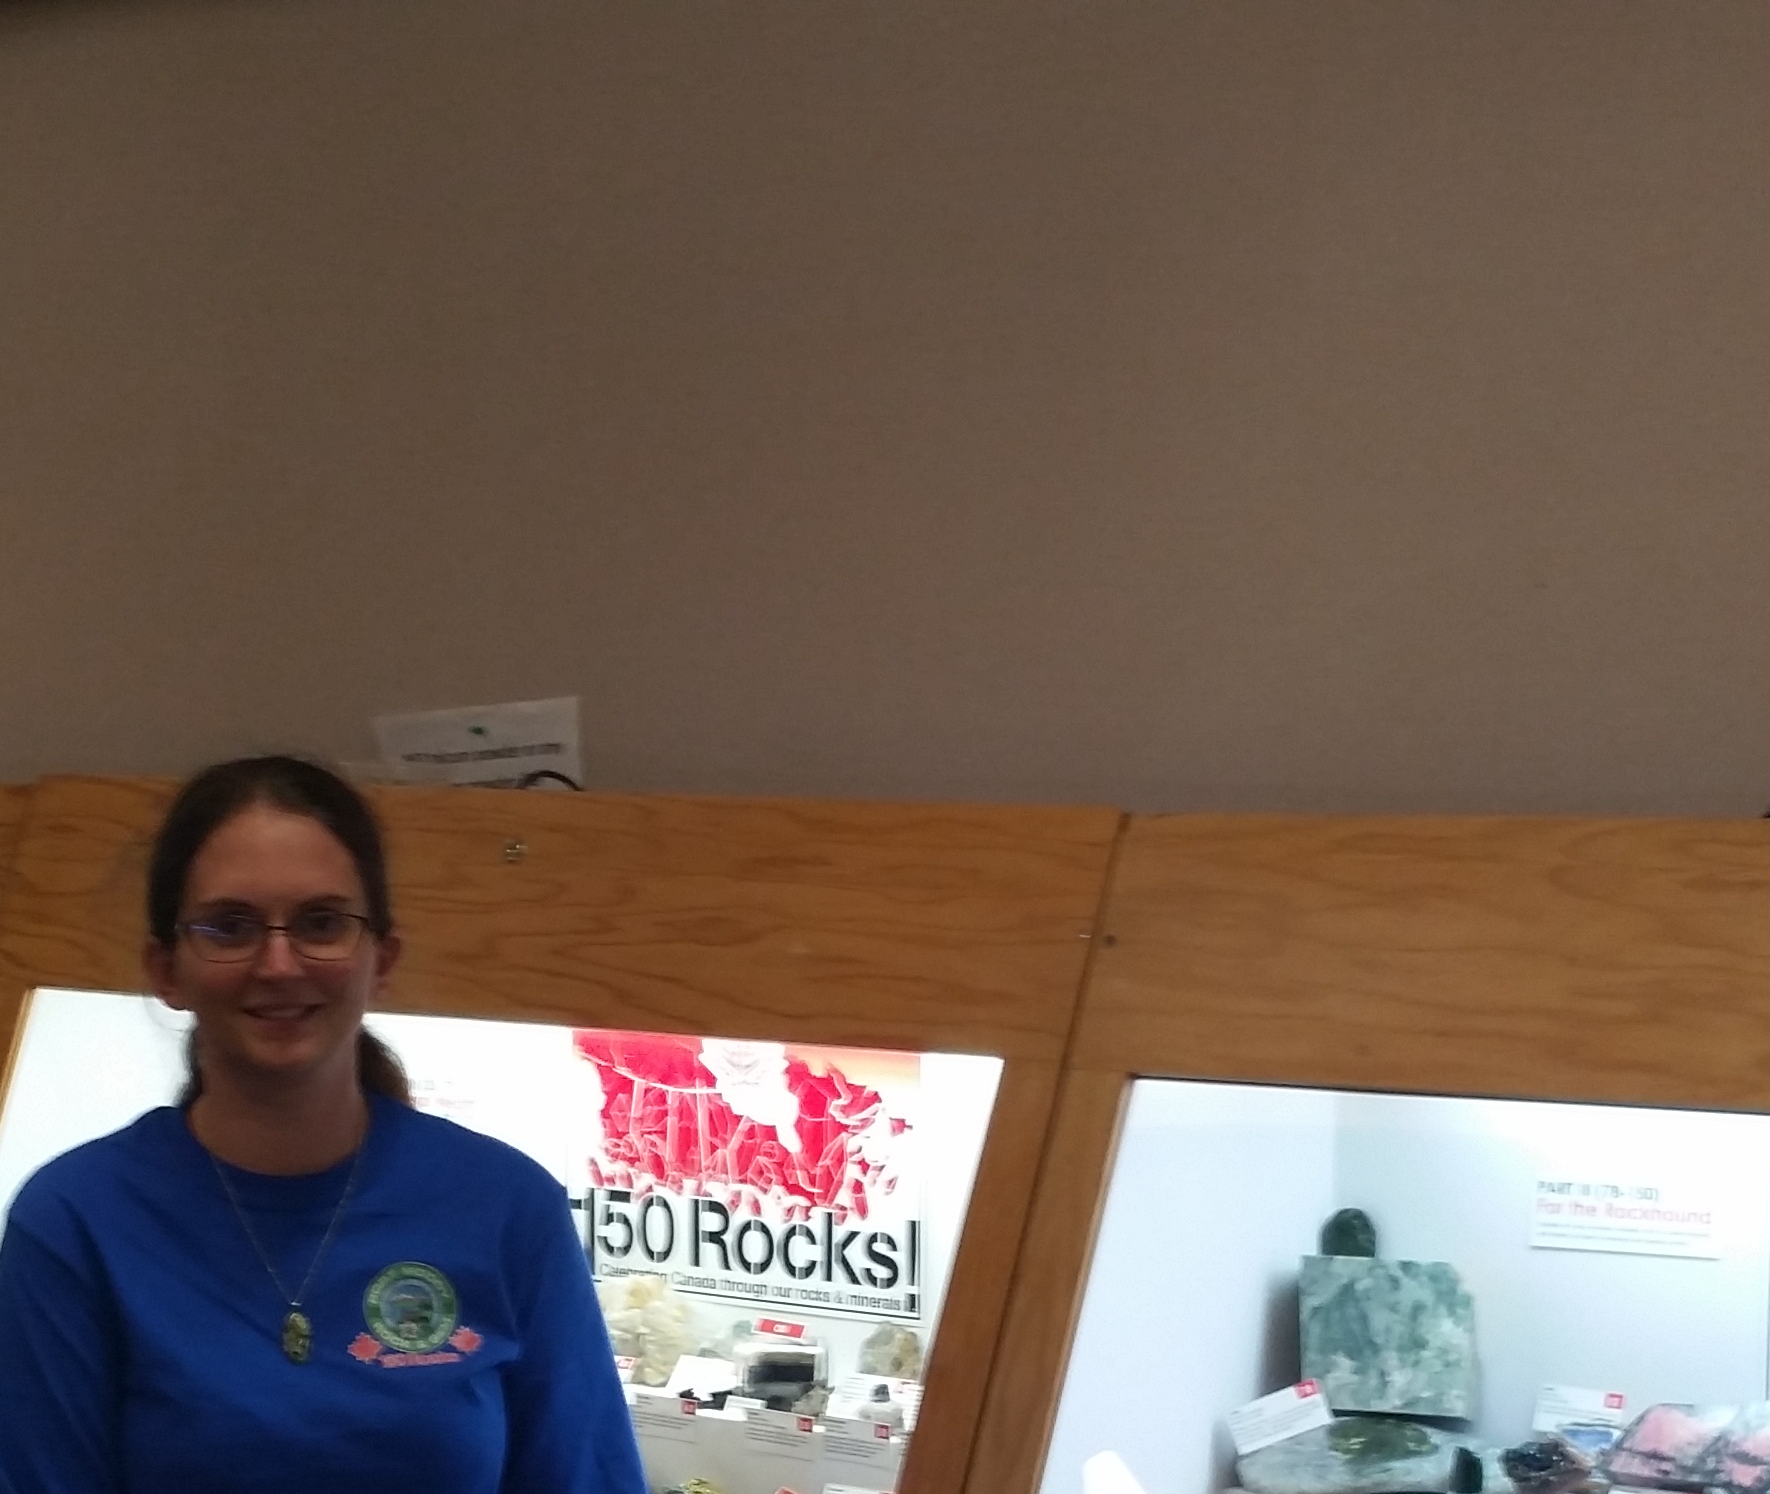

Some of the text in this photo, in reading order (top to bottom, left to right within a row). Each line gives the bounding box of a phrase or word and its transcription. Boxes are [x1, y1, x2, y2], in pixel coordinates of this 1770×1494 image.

[570, 1187, 921, 1312] 150 Rocks!
[672, 1271, 716, 1290] Canada
[720, 1278, 767, 1298] through
[772, 1286, 792, 1298] our
[795, 1287, 830, 1303] rocks
[846, 1293, 900, 1311] minerals
